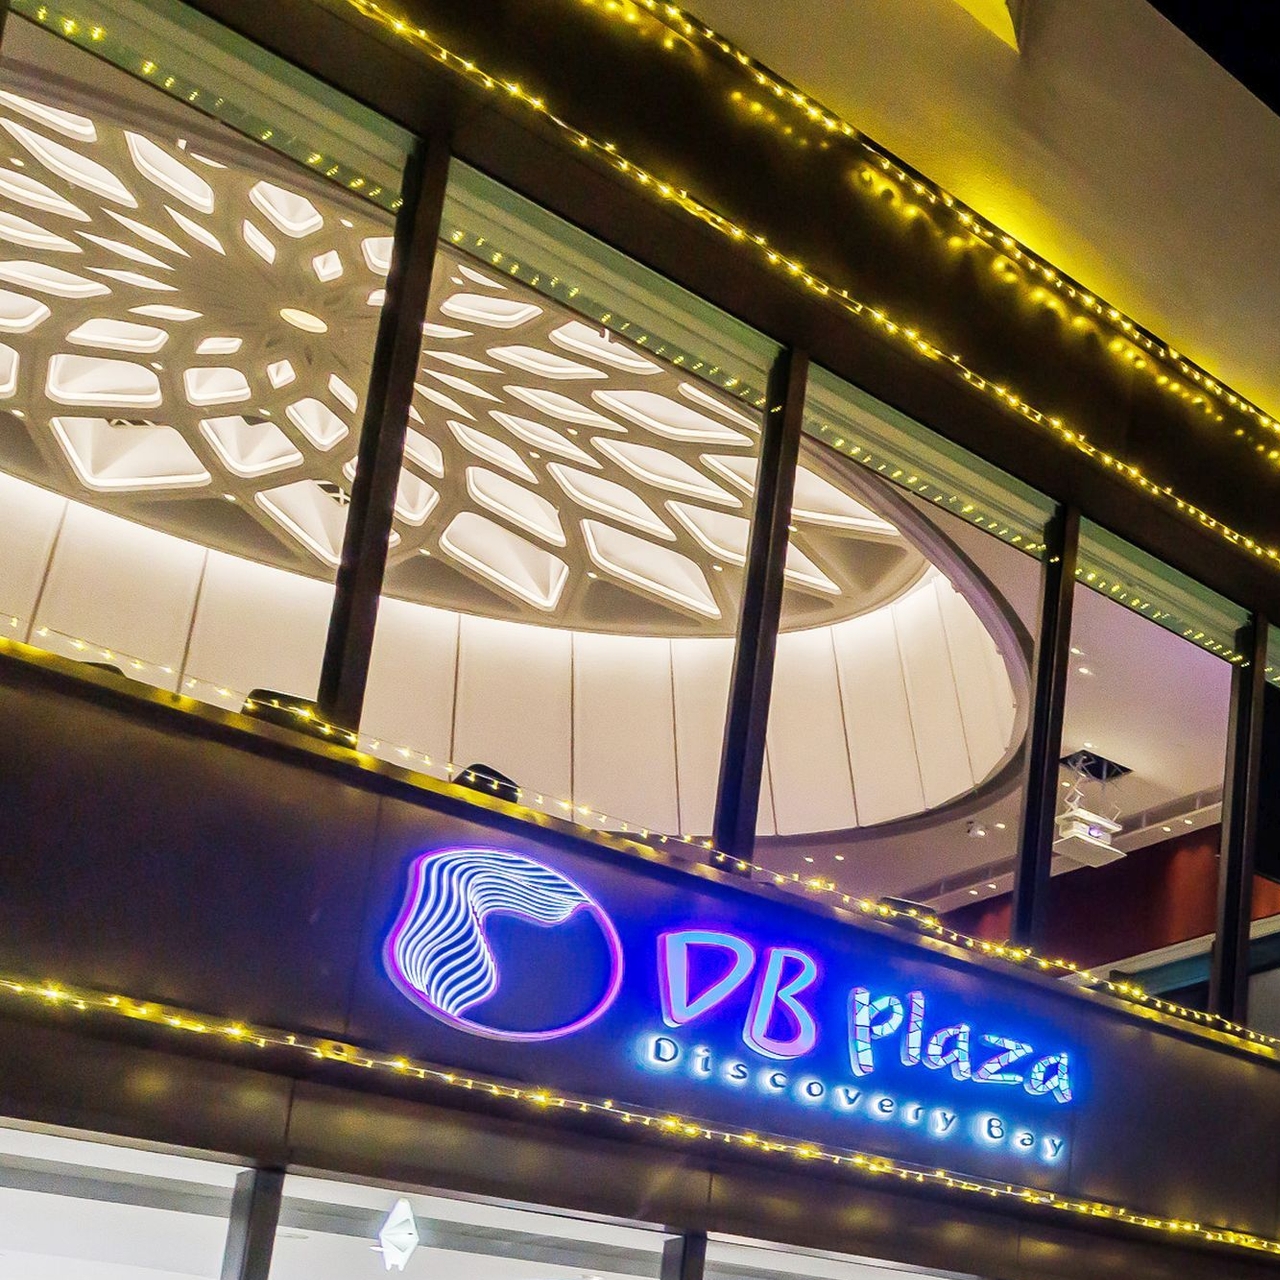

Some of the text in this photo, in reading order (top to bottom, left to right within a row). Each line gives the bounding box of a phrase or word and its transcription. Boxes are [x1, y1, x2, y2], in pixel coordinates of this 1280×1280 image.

[656, 930, 819, 1059] DB
[650, 1036, 1065, 1160] Discovery Bay
